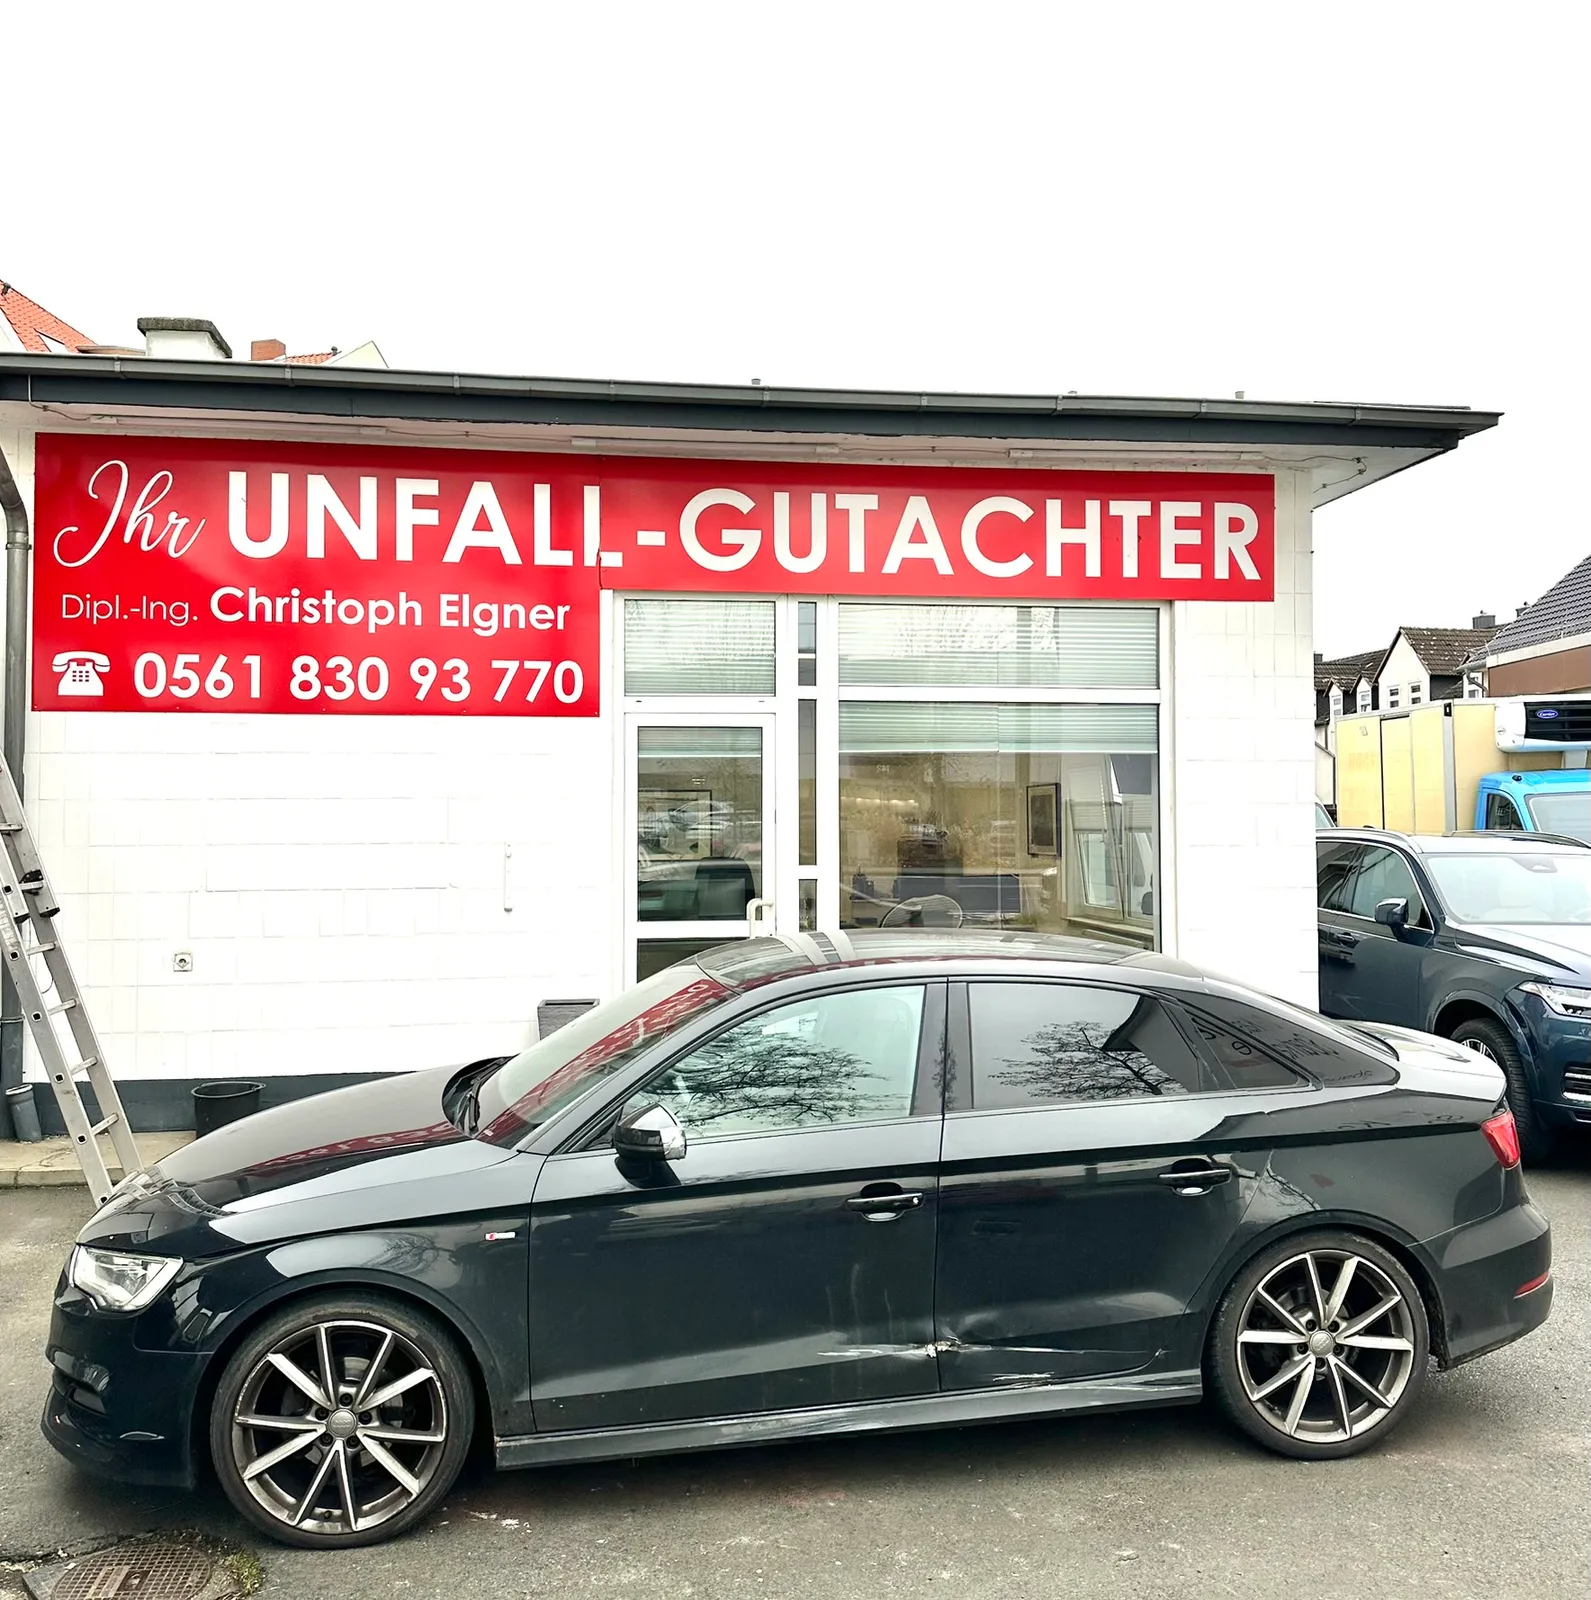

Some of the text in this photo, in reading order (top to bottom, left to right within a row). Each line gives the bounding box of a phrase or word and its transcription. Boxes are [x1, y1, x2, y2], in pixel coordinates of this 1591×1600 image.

[53, 459, 1261, 582] Ihr UNFALL-GUTACHTER
[61, 586, 571, 638] Dipl.-Ing. Christoph Elgner
[133, 652, 585, 704] 0561 830 93 770
